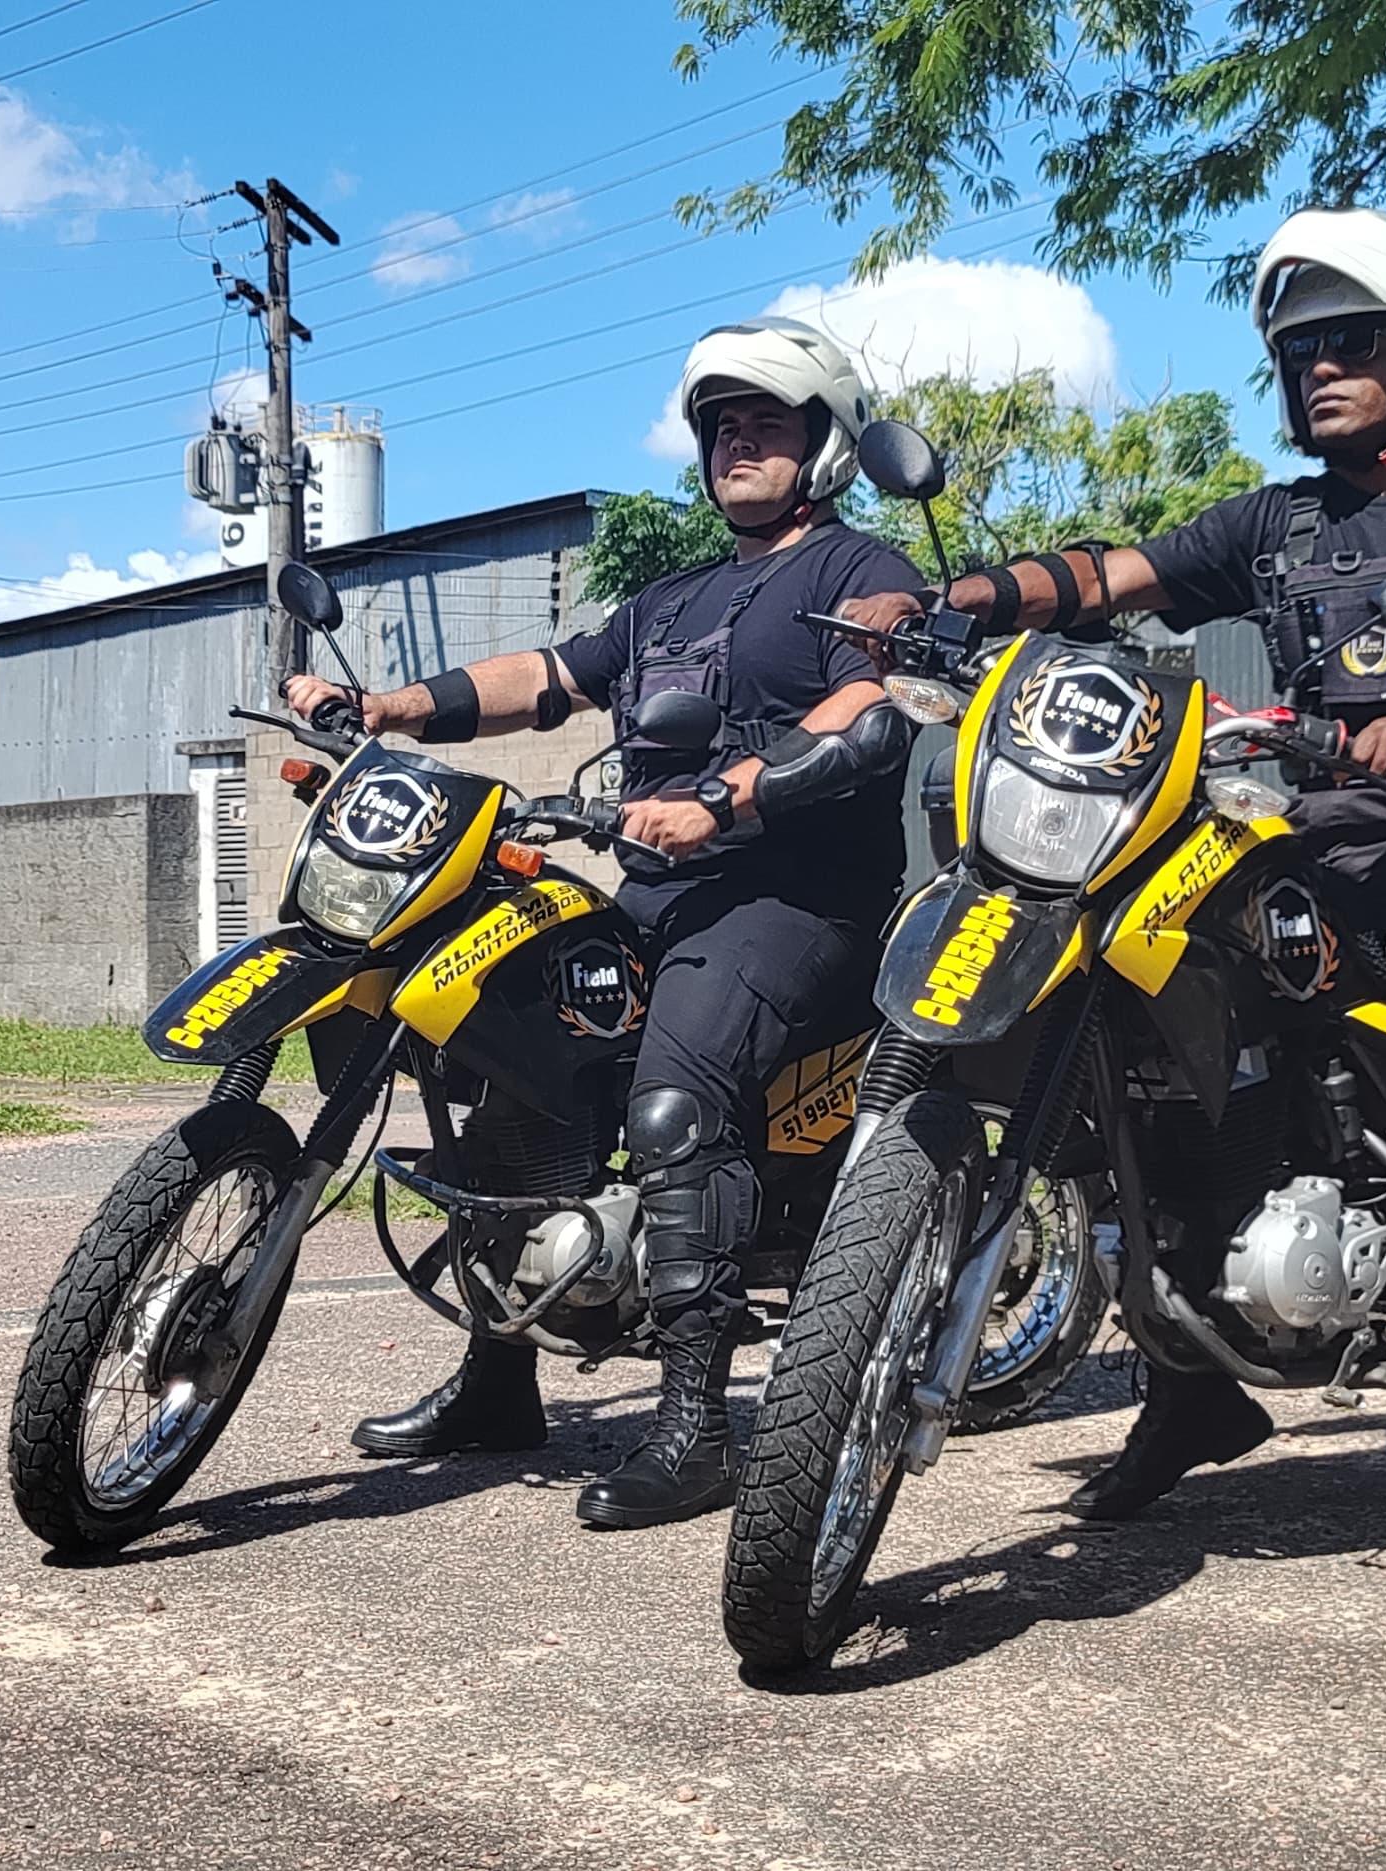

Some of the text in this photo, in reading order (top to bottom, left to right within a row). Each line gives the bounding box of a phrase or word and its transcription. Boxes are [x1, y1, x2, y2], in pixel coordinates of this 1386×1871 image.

[1056, 682, 1122, 724] Field
[1029, 756, 1089, 786] HONDA
[359, 786, 411, 821] Field
[432, 884, 574, 978] ALARMES
[1269, 908, 1313, 939] Field
[435, 893, 583, 993] MONITORADOS
[572, 962, 619, 988] Field
[781, 1114, 804, 1143] 51
